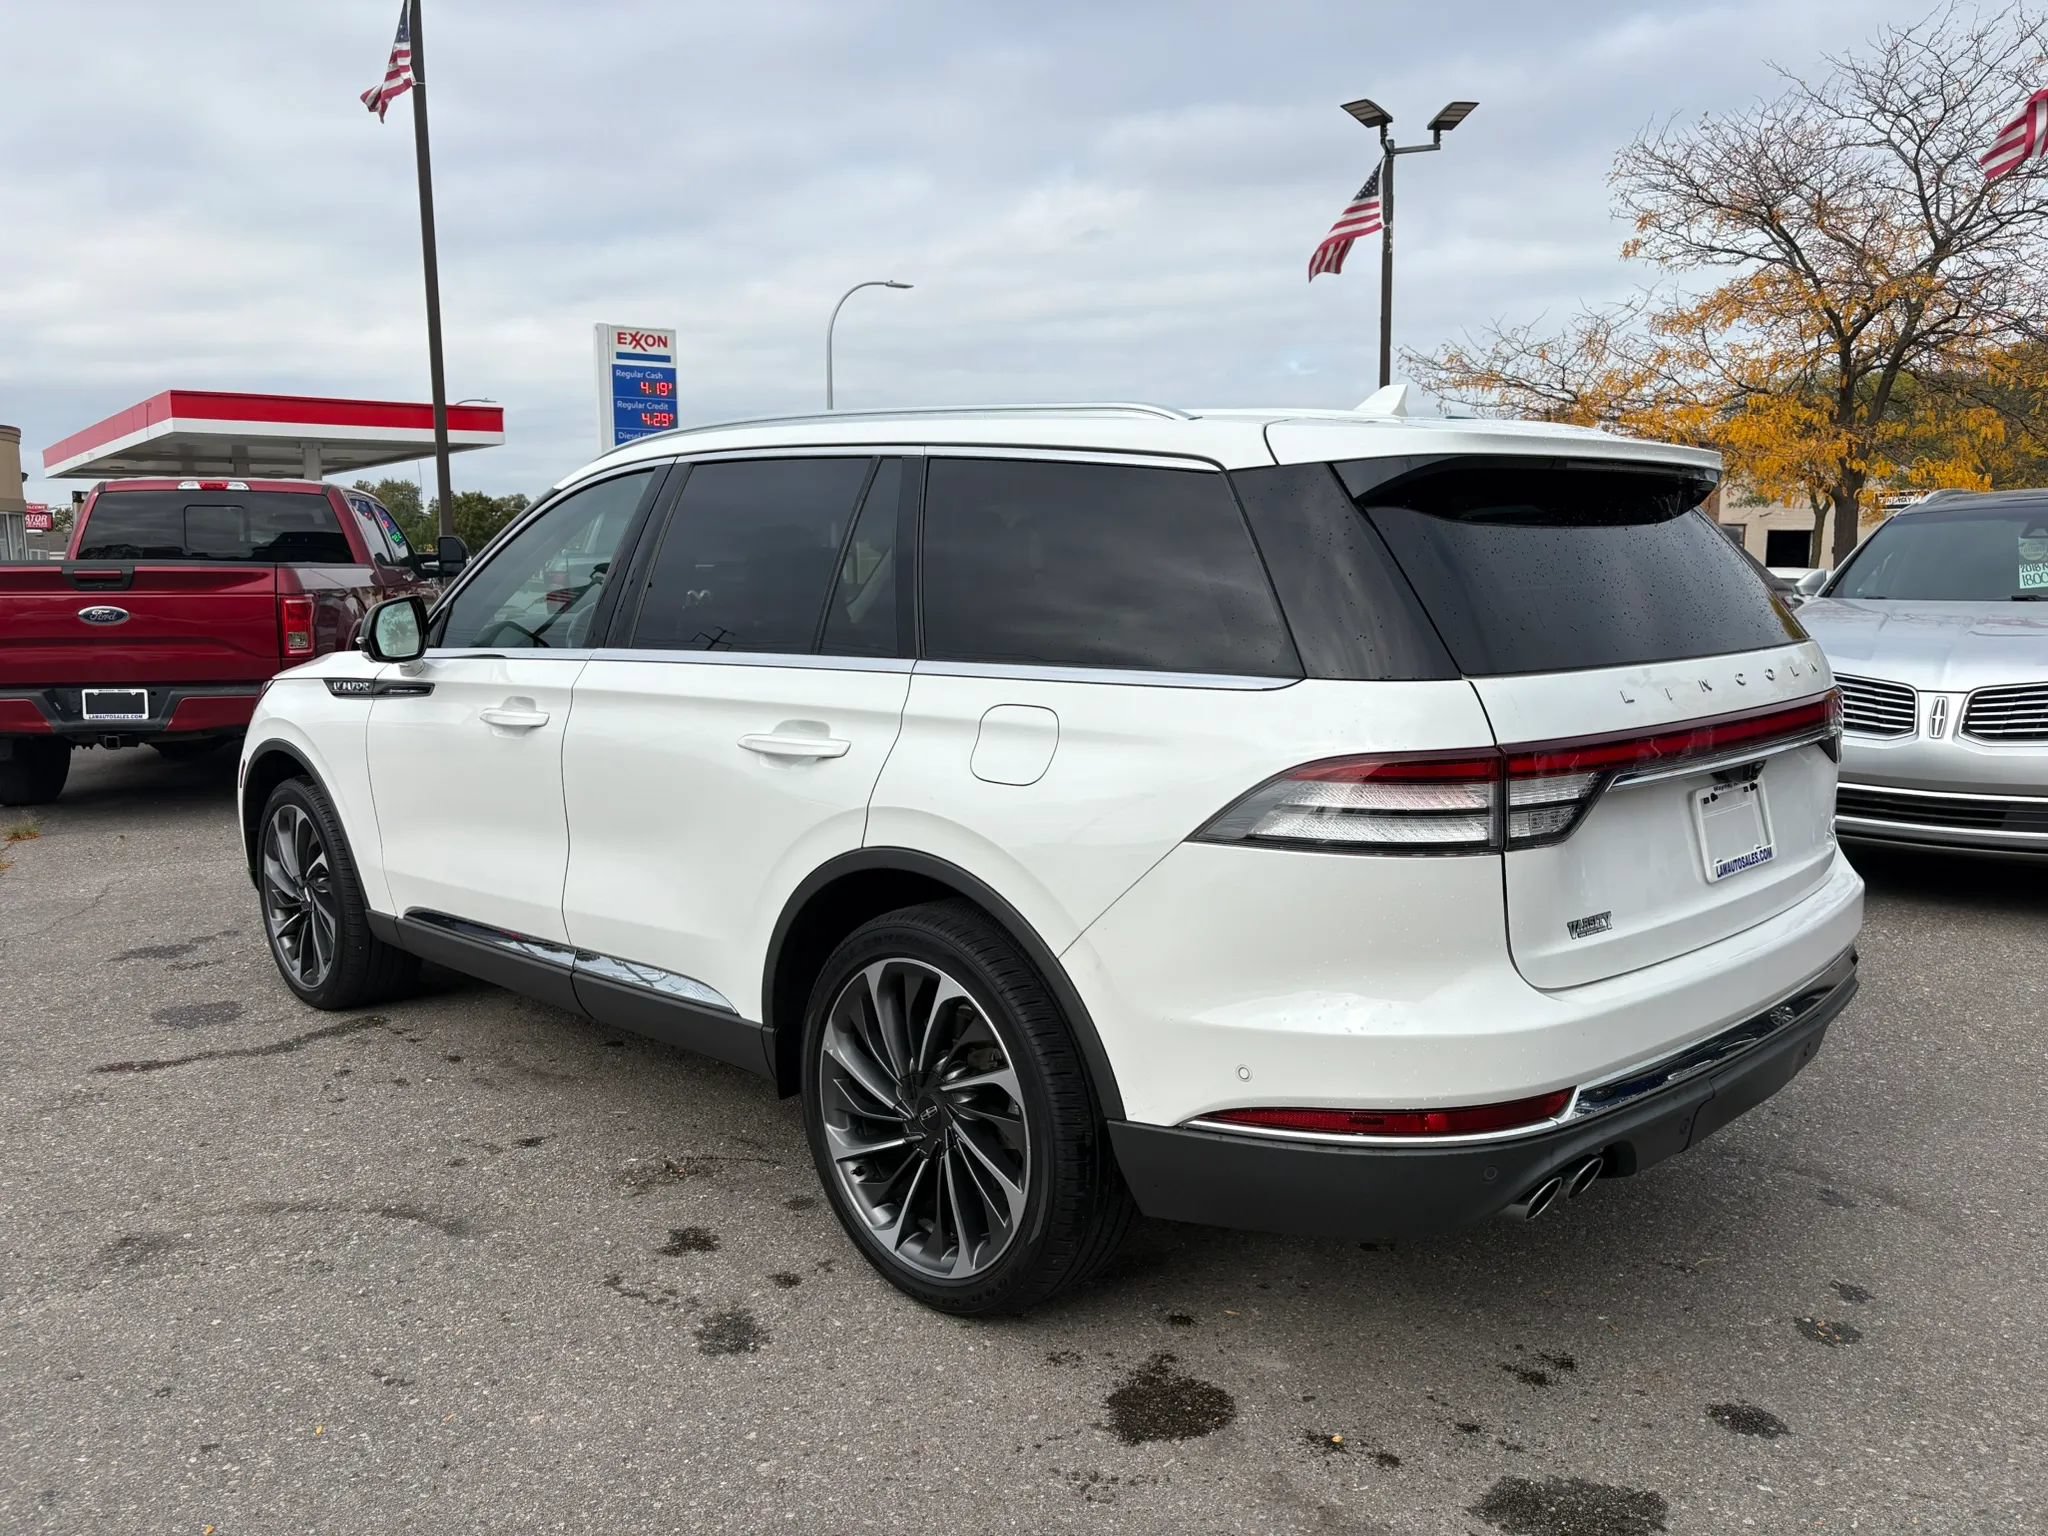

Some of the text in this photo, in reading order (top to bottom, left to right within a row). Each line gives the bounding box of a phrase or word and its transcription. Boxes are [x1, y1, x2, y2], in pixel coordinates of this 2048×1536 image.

[617, 331, 668, 352] EXXON
[615, 369, 663, 380] Regular Cash
[616, 400, 669, 411] Regular Credit
[91, 608, 118, 621] Ford
[1619, 662, 1818, 704] LINCOLN
[1567, 911, 1612, 940] VARSITY
